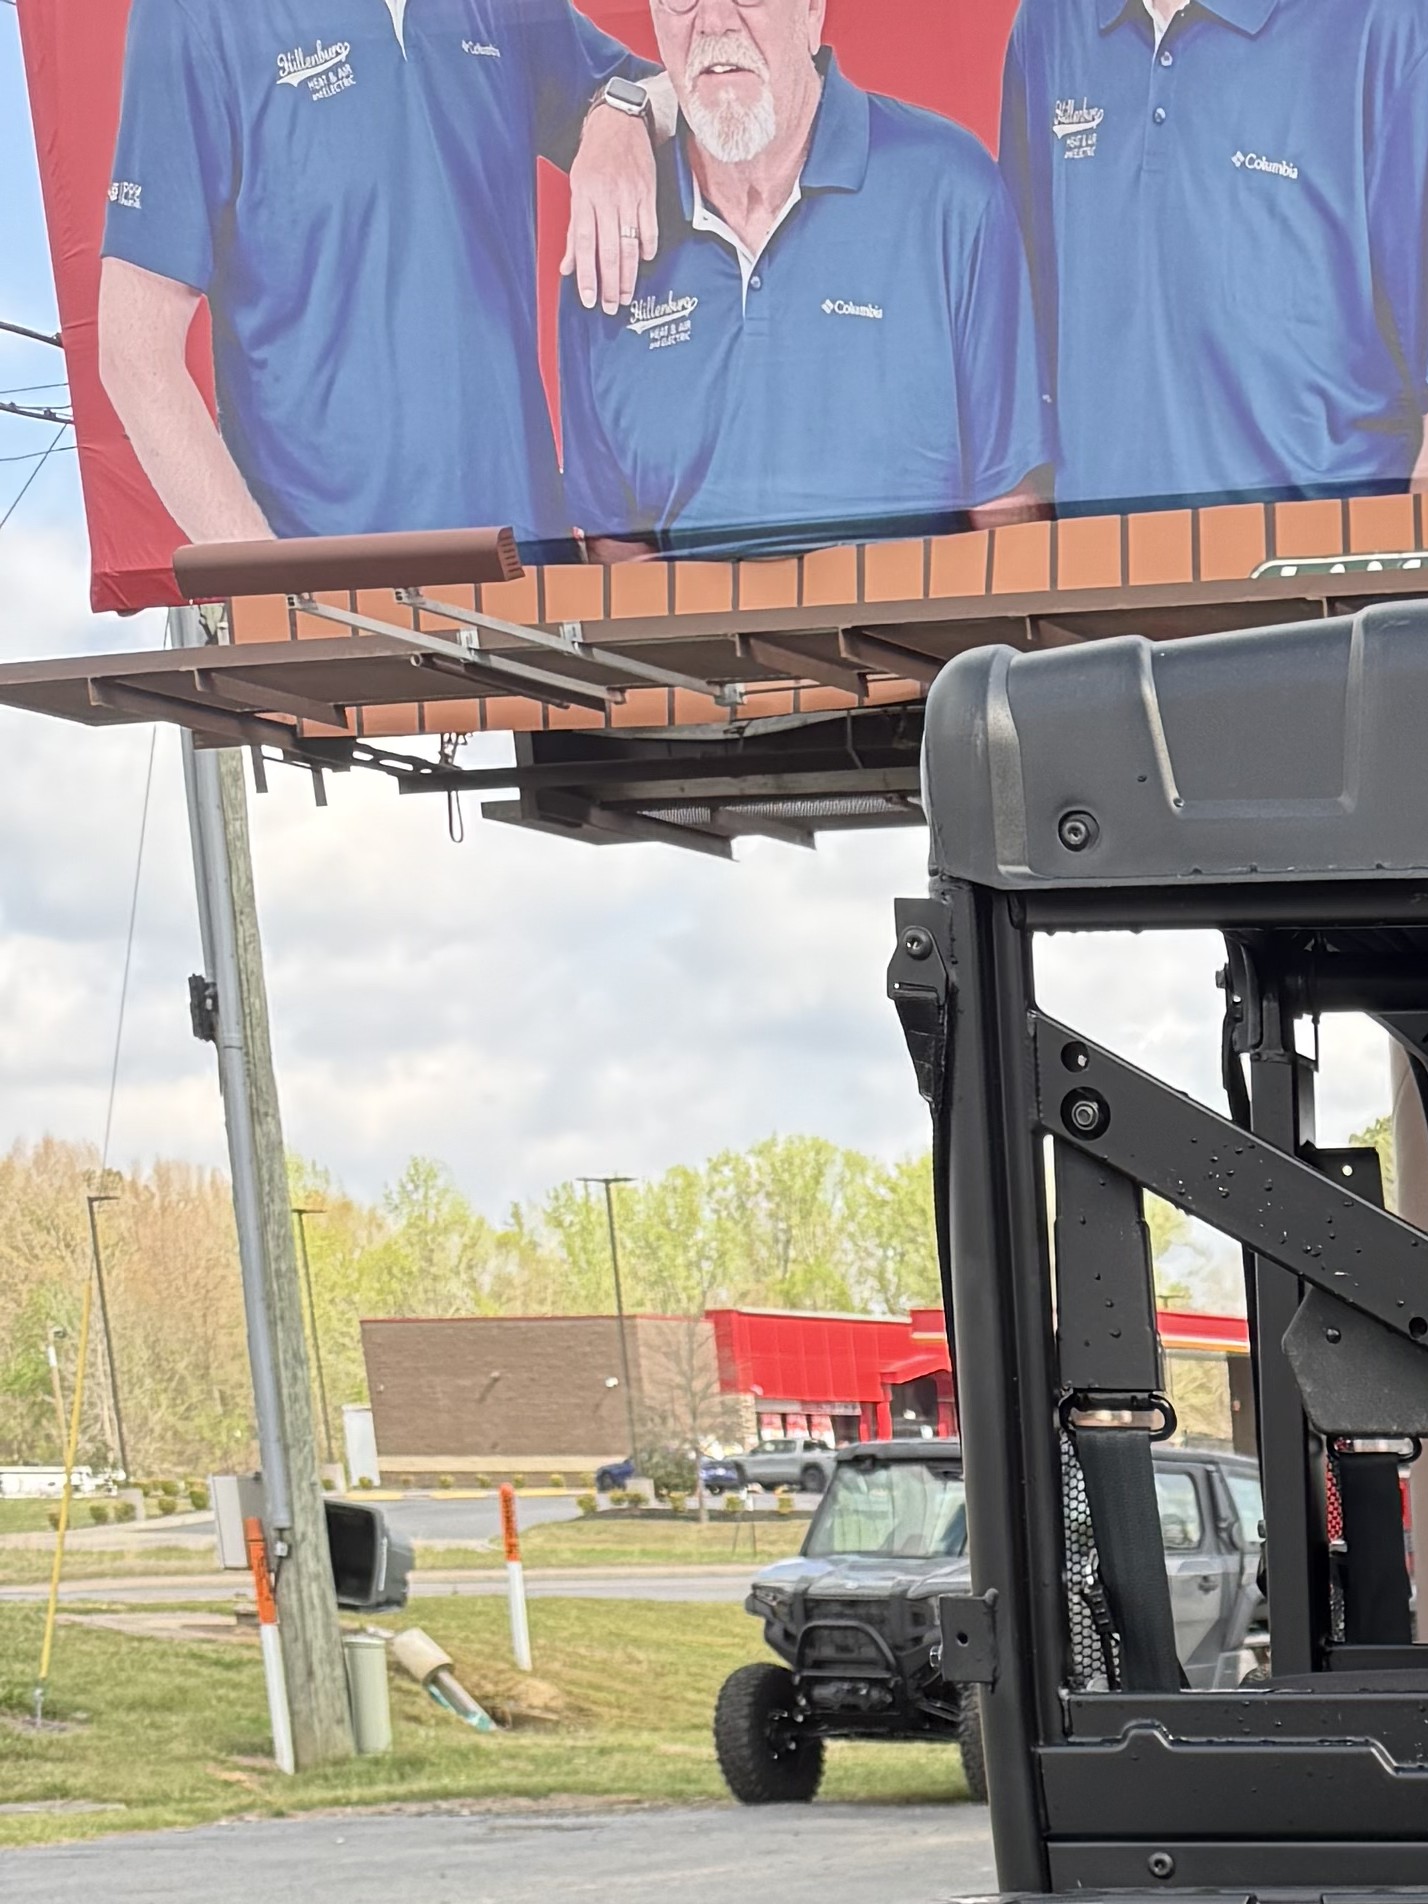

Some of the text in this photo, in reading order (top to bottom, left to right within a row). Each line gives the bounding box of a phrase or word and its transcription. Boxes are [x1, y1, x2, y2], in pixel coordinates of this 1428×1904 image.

[276, 39, 351, 79] Hillenburg
[1245, 152, 1299, 180] Columbia
[834, 299, 883, 319] Columbia
